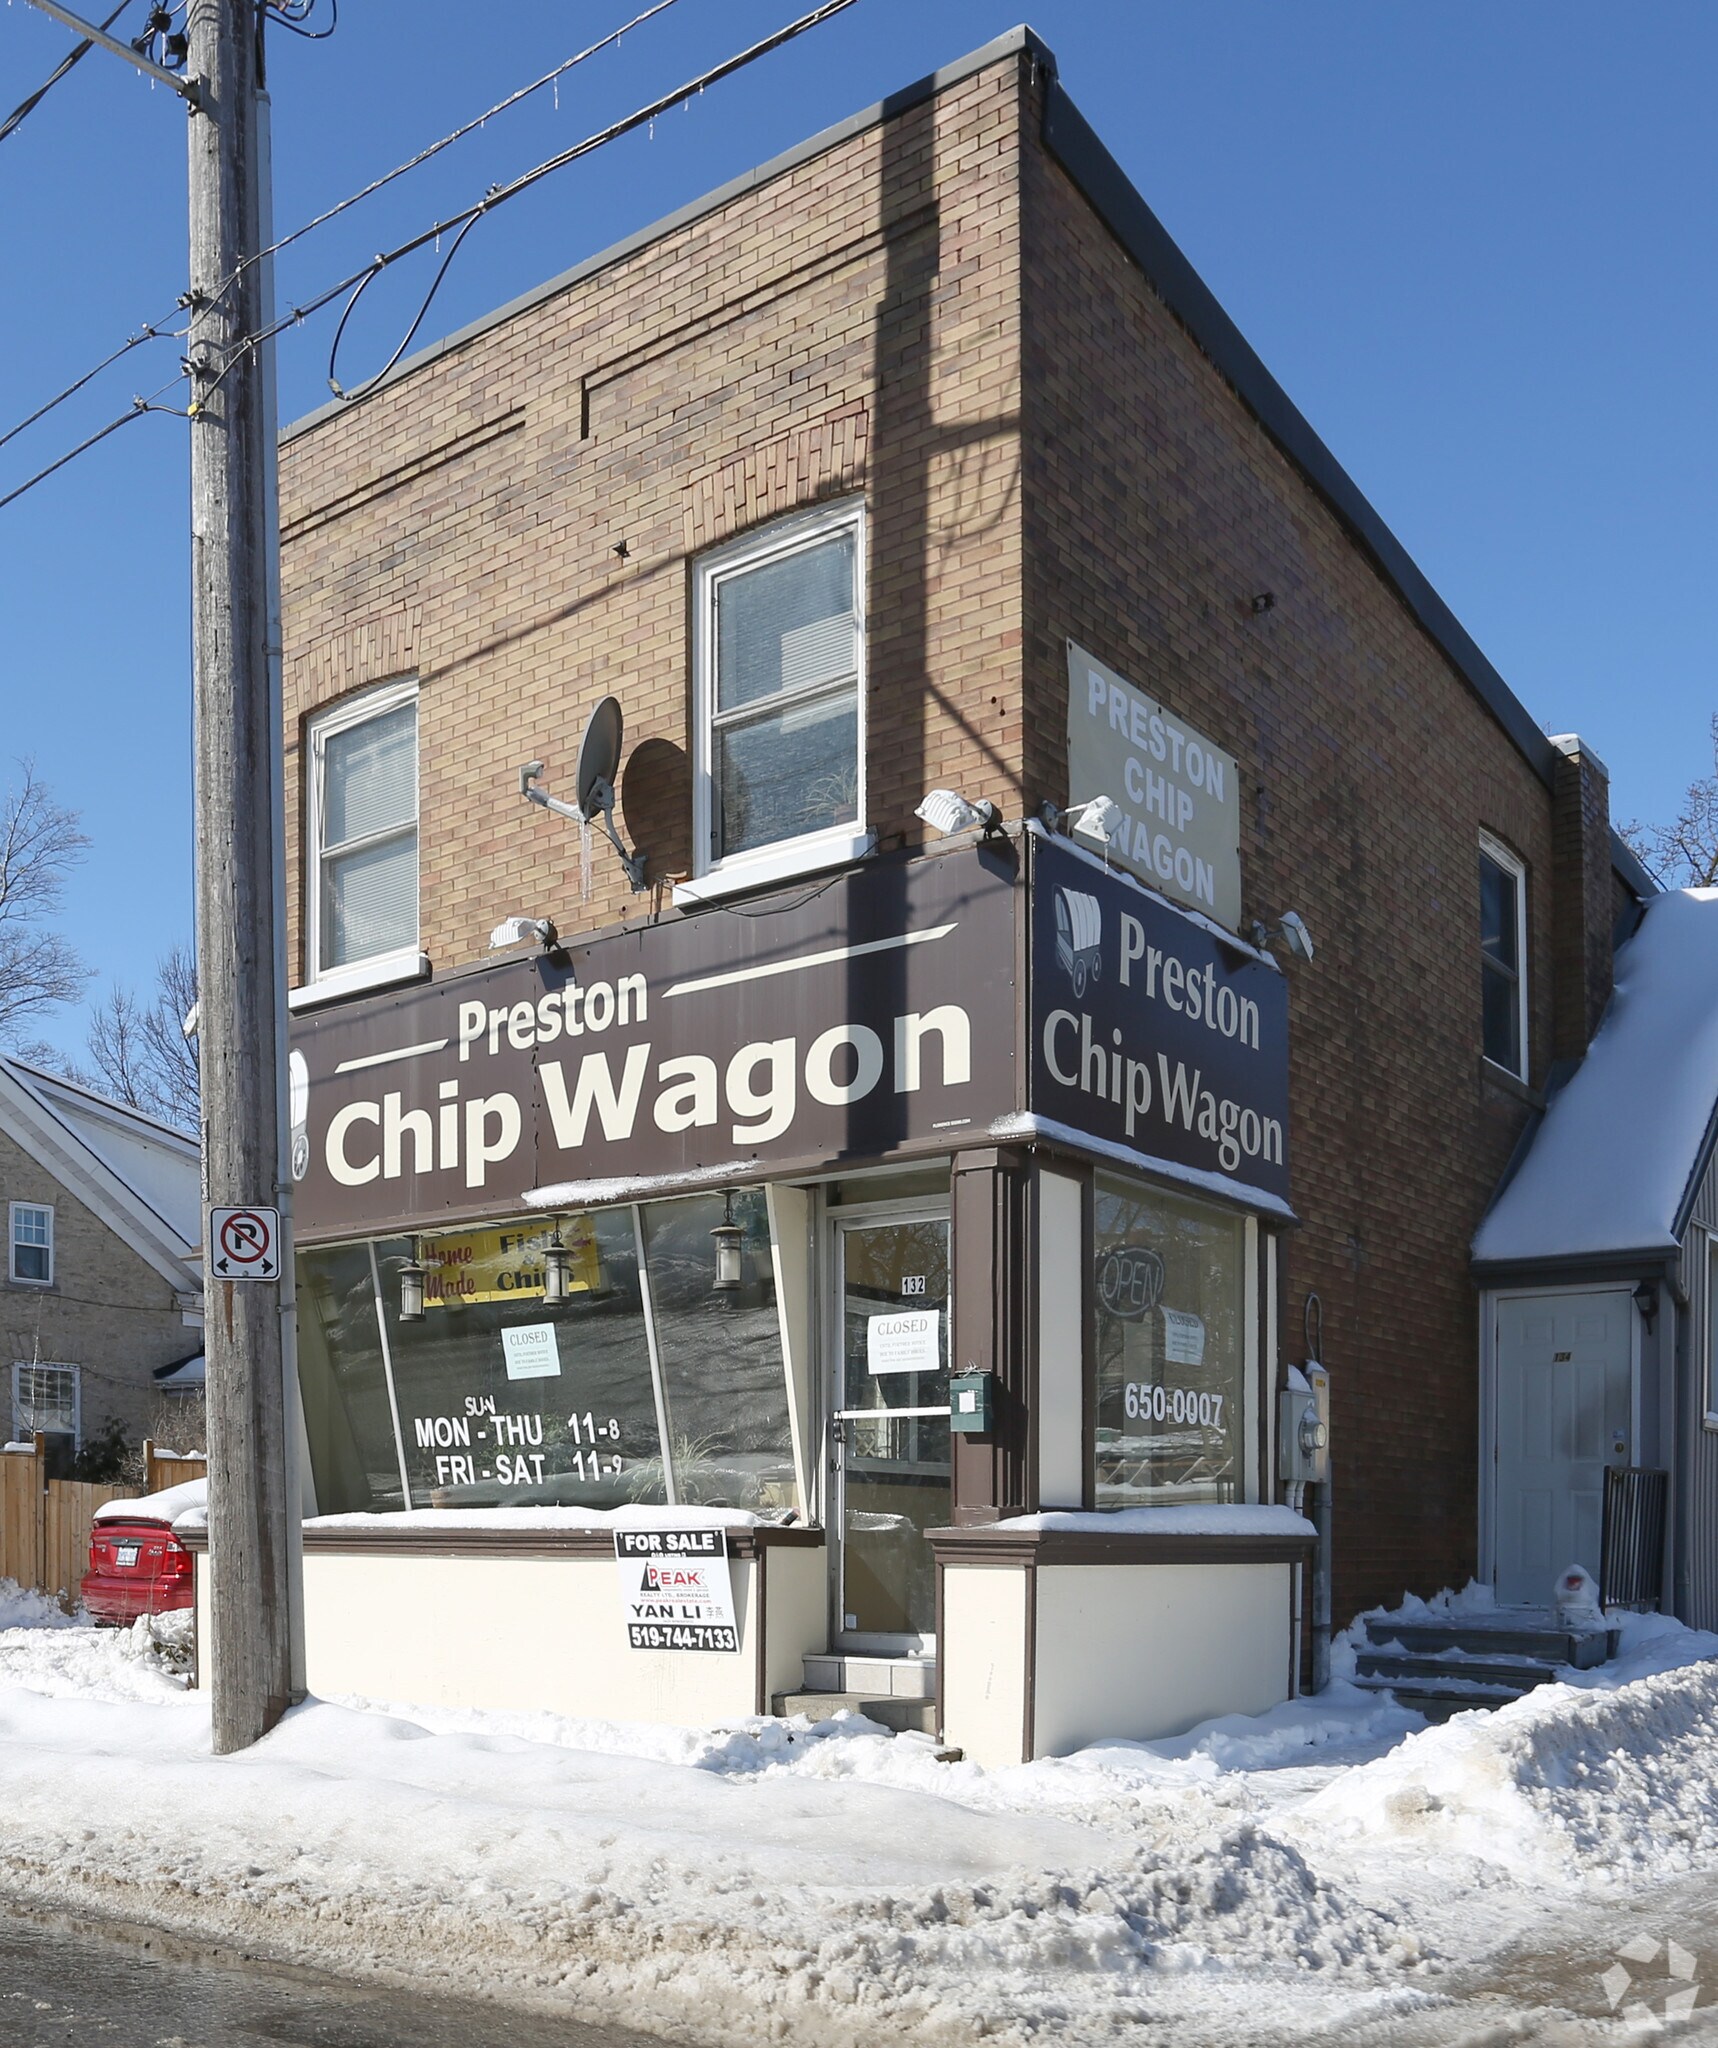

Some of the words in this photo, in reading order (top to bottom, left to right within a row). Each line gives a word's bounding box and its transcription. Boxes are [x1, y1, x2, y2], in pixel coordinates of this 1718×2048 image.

[1087, 669, 1224, 802] PRESTON
[1124, 757, 1193, 833] CHIP
[1119, 911, 1260, 1051] Preston
[458, 971, 648, 1062] Preston
[325, 1080, 522, 1188] Chip
[536, 1004, 972, 1149] Wagon
[1043, 1009, 1151, 1138] Chip
[1157, 1052, 1283, 1171] Wagon
[424, 1242, 474, 1268] Home
[425, 1270, 477, 1301] Made
[903, 1277, 924, 1294] 132
[1103, 1255, 1160, 1307] OPEN
[509, 1330, 548, 1347] CLOSED
[877, 1318, 928, 1336] CLOSED
[1125, 1382, 1223, 1427] 650-0007
[414, 1416, 471, 1448] MON
[489, 1414, 544, 1446] THU
[567, 1411, 620, 1444] 11-8
[435, 1455, 476, 1485] FRI
[495, 1453, 546, 1485] SAT
[572, 1450, 622, 1482] 11-9
[624, 1534, 663, 1551] FOR
[666, 1533, 715, 1551] SALE
[648, 1567, 701, 1586] PEAK
[631, 1604, 674, 1618] YAN
[681, 1604, 702, 1619] LI
[631, 1626, 735, 1649] 519-744-7133
